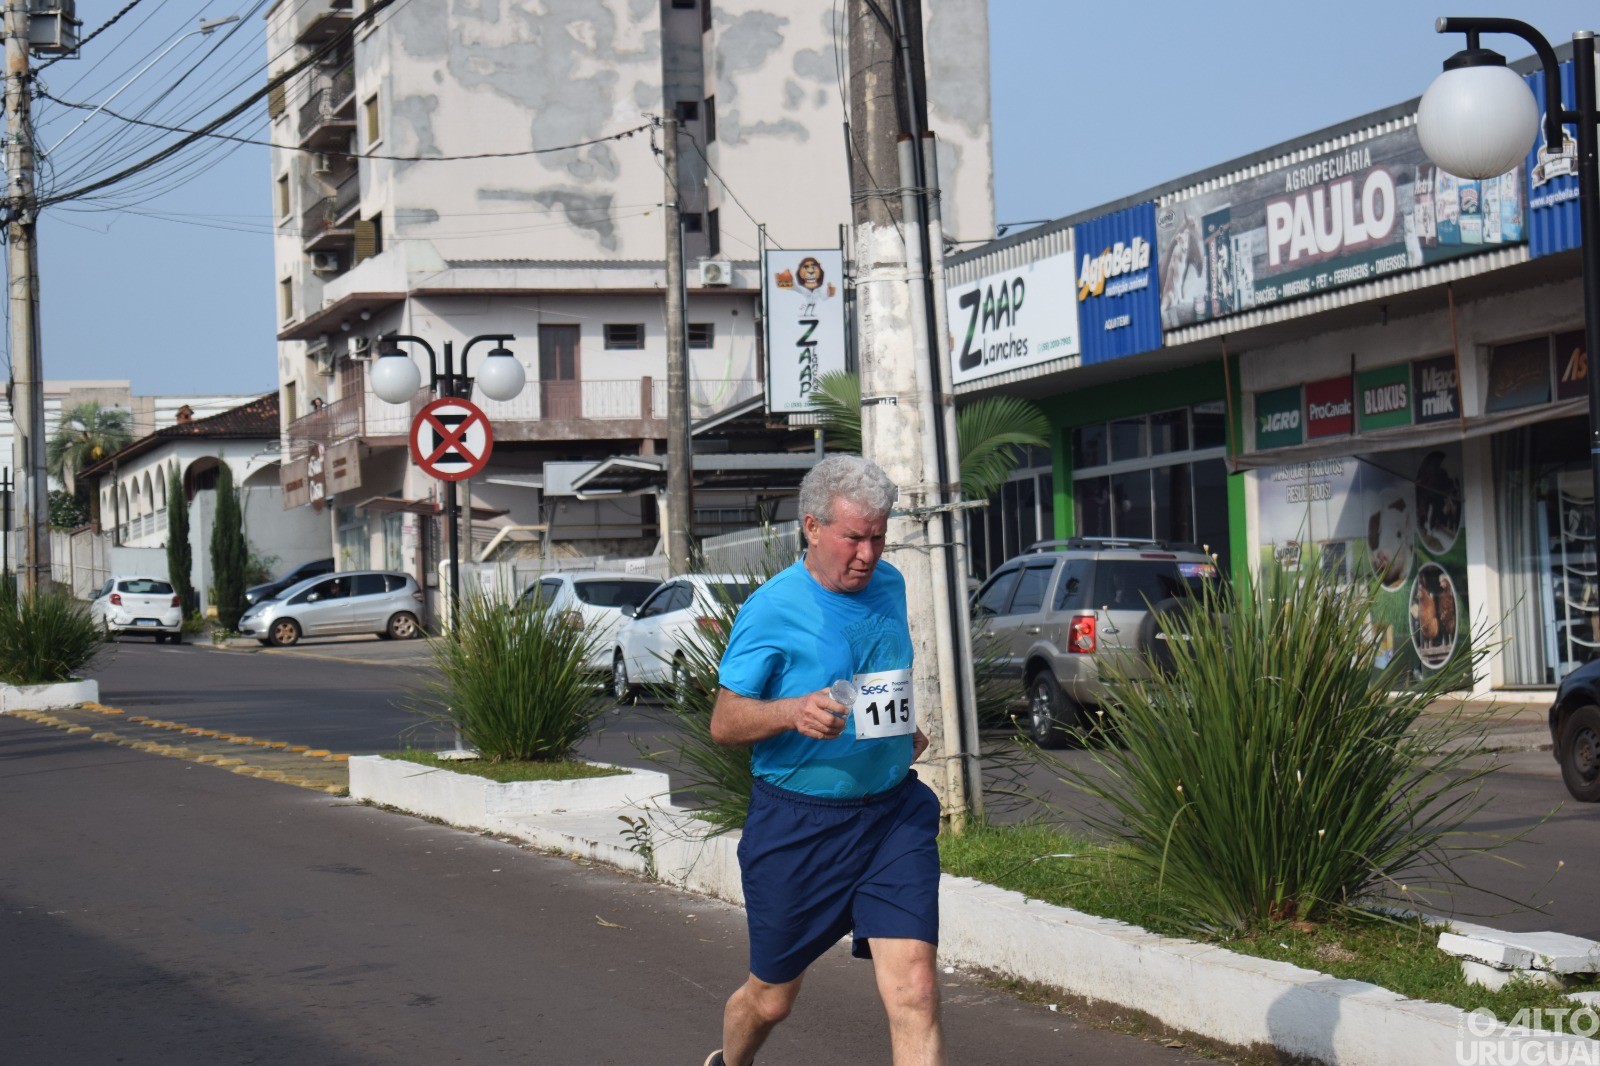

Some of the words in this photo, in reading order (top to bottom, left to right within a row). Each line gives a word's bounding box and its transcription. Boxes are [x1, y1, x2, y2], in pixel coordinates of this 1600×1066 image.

[1286, 147, 1371, 192] AGROPECUÁRIA
[1266, 169, 1395, 267] PAULO
[1078, 237, 1150, 293] AgroBella
[1283, 278, 1309, 297] MINERAIS
[1316, 274, 1328, 288] PET
[1334, 263, 1369, 284] FERRAGENS
[1375, 254, 1406, 272] DIVERSOS
[959, 276, 1025, 372] ZAAP
[796, 319, 820, 399] ZAAP
[811, 346, 820, 392] Lanche
[983, 332, 1028, 366] Lanches
[1262, 409, 1300, 433] AGRO
[1364, 384, 1407, 415] BLOKUS
[1422, 390, 1454, 417] milk
[866, 698, 909, 726] 115
